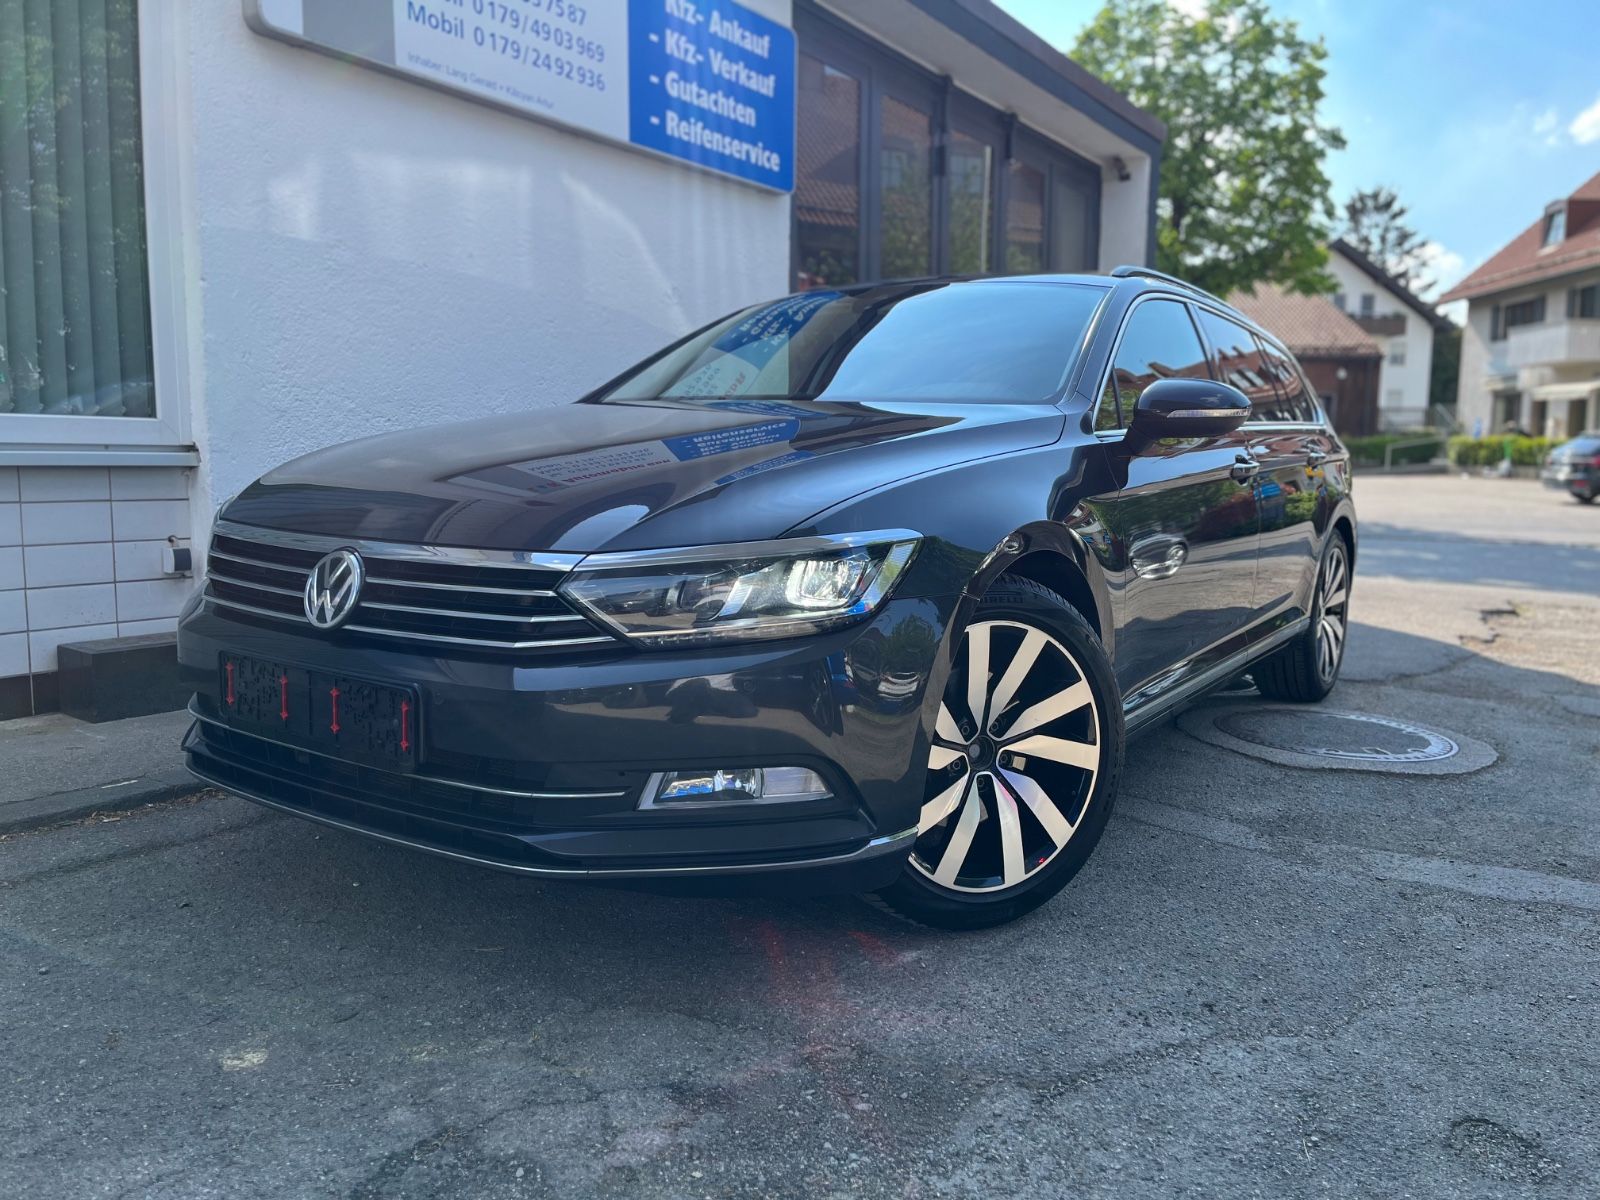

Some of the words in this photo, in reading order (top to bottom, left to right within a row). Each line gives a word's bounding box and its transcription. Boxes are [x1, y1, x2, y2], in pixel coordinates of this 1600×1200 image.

[407, 1, 464, 39] Mobil
[708, 10, 770, 58] Ankauf
[665, 28, 704, 65] Kfz-
[709, 47, 776, 98] Verkauf
[665, 71, 756, 127] Gutachten
[665, 110, 780, 172] Reifenservice
